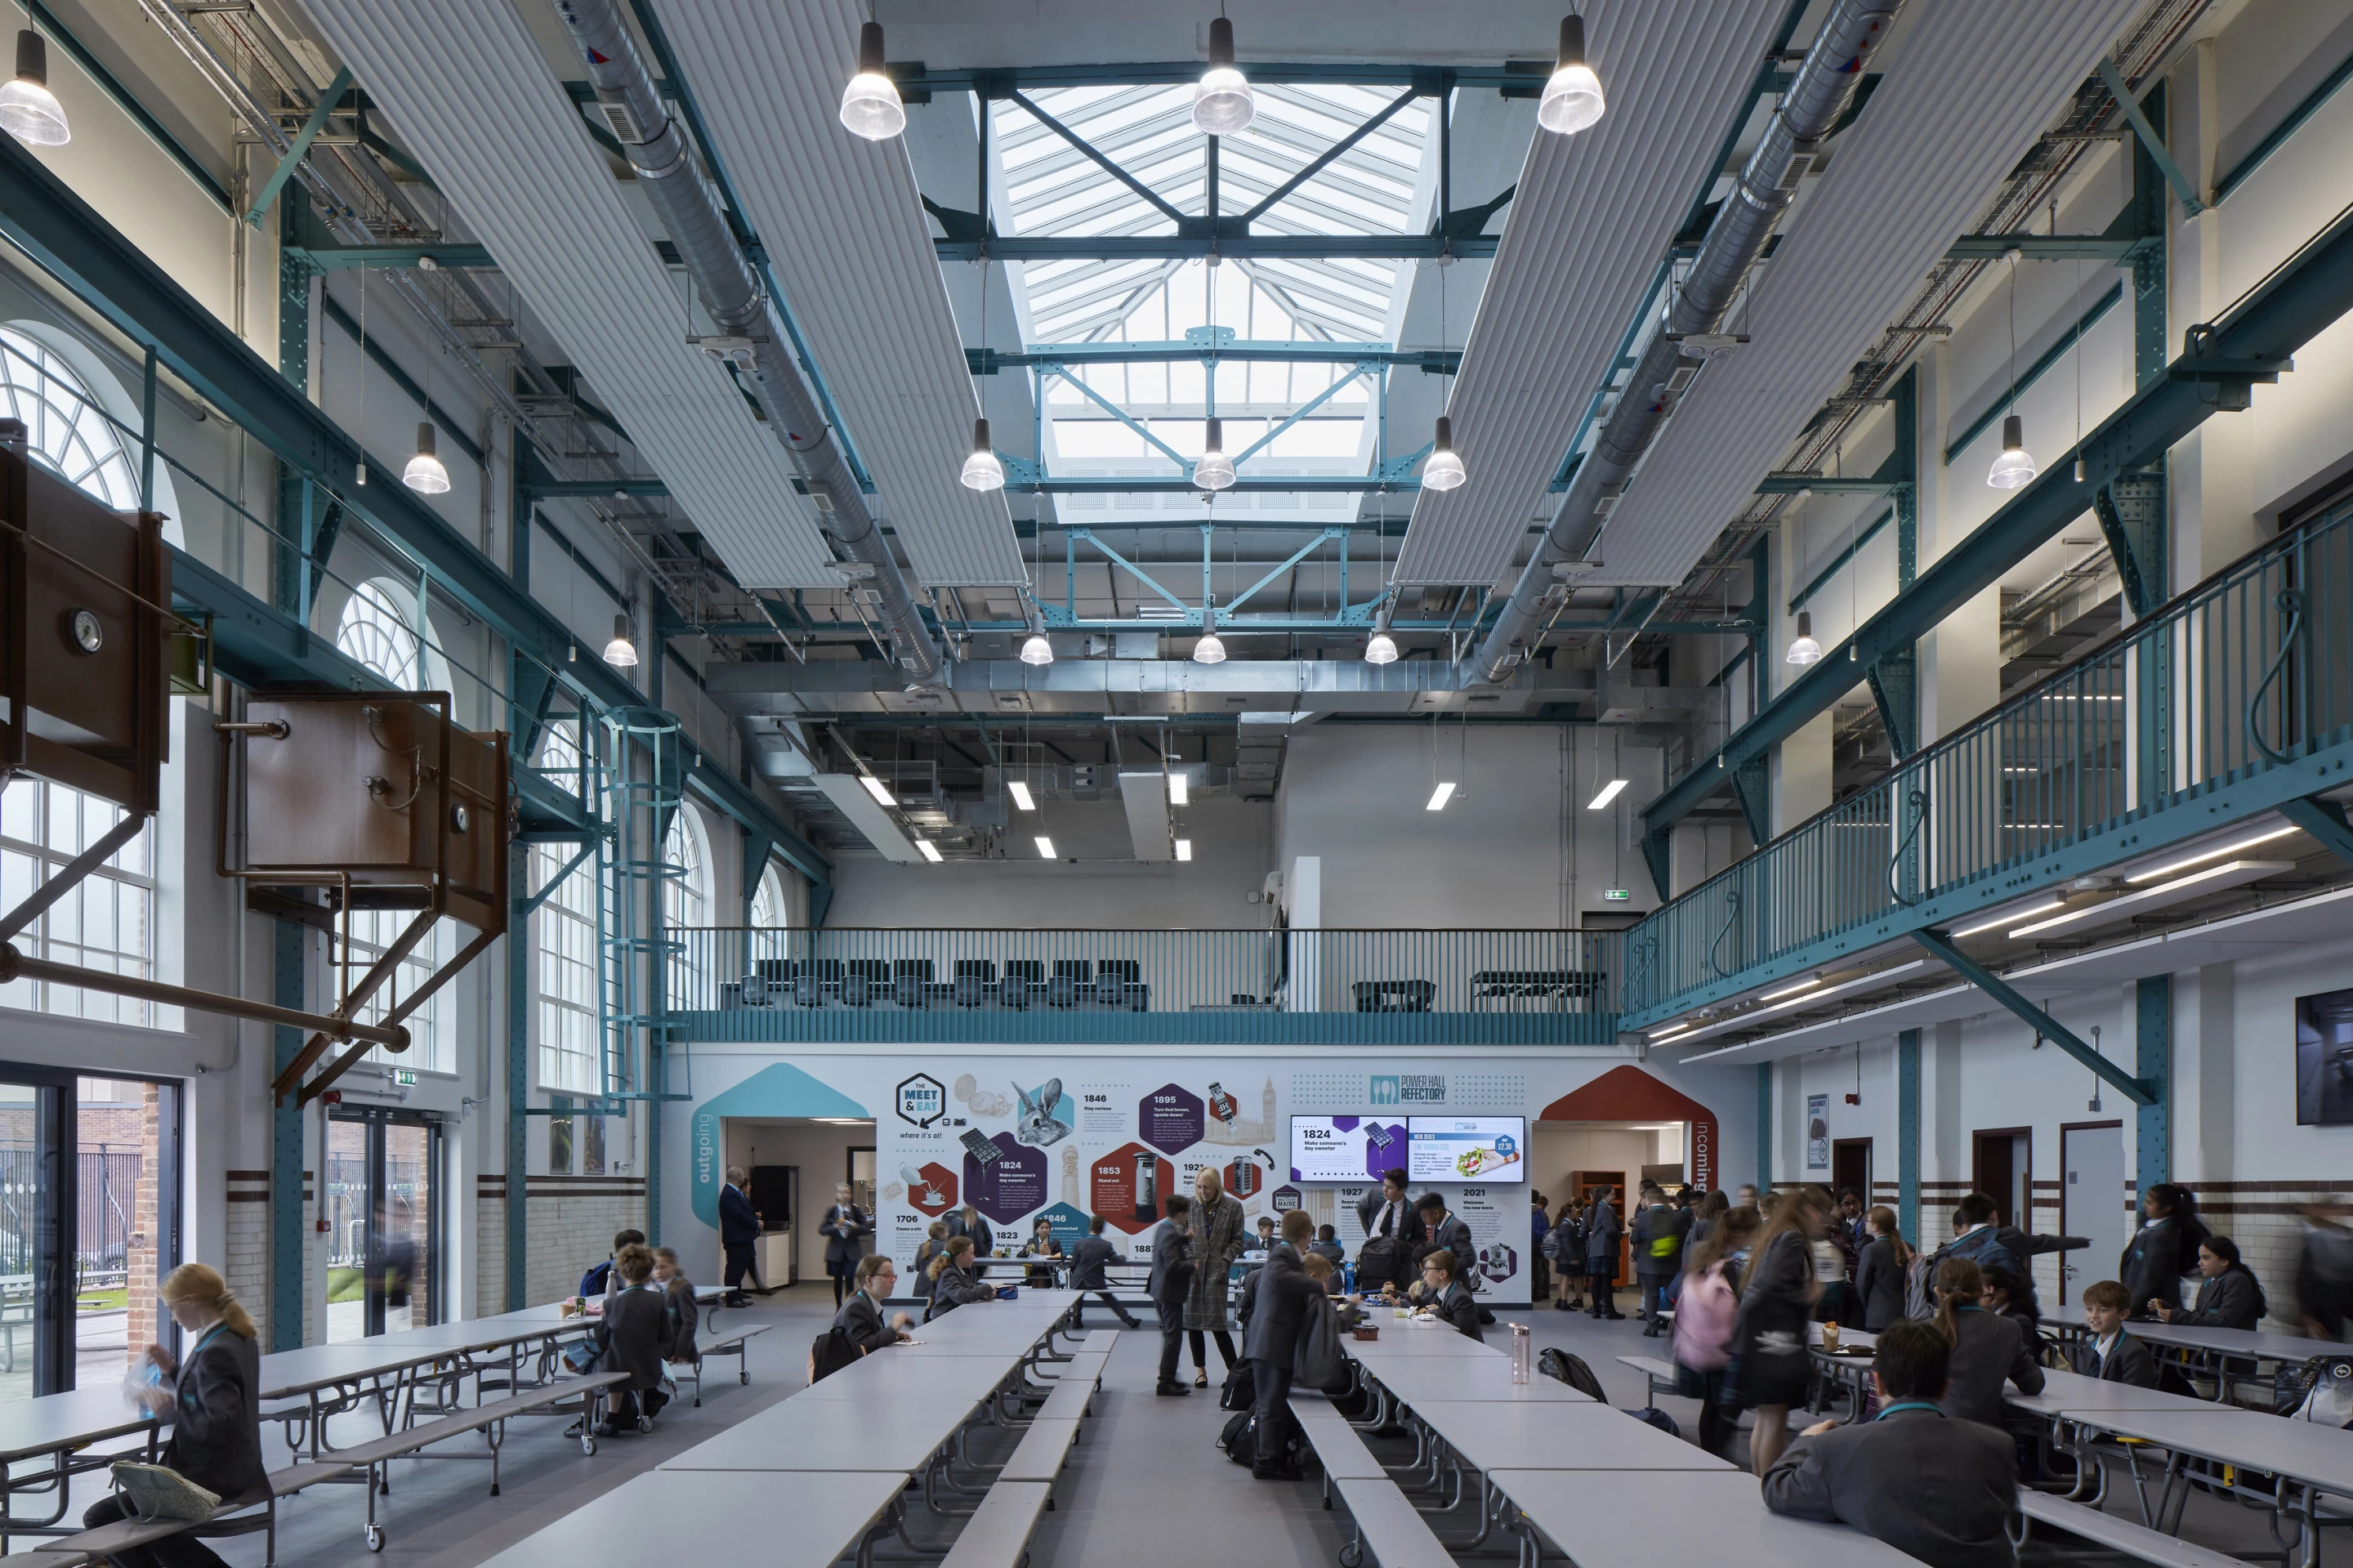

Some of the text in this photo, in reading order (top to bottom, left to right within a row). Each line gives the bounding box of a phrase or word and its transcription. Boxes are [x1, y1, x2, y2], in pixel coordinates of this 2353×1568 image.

[1401, 1075, 1446, 1088] POWER HALL
[904, 1090, 937, 1100] MEET
[1401, 1088, 1446, 1101] REFECTORY
[1154, 1096, 1176, 1104] 1895
[905, 1101, 937, 1111] & EAT
[1303, 1130, 1331, 1138] 1824
[697, 1114, 713, 1183] outgoing
[1498, 1142, 1512, 1150] £2.30
[1694, 1122, 1711, 1193] incoming
[996, 1231, 1018, 1240] 1823
